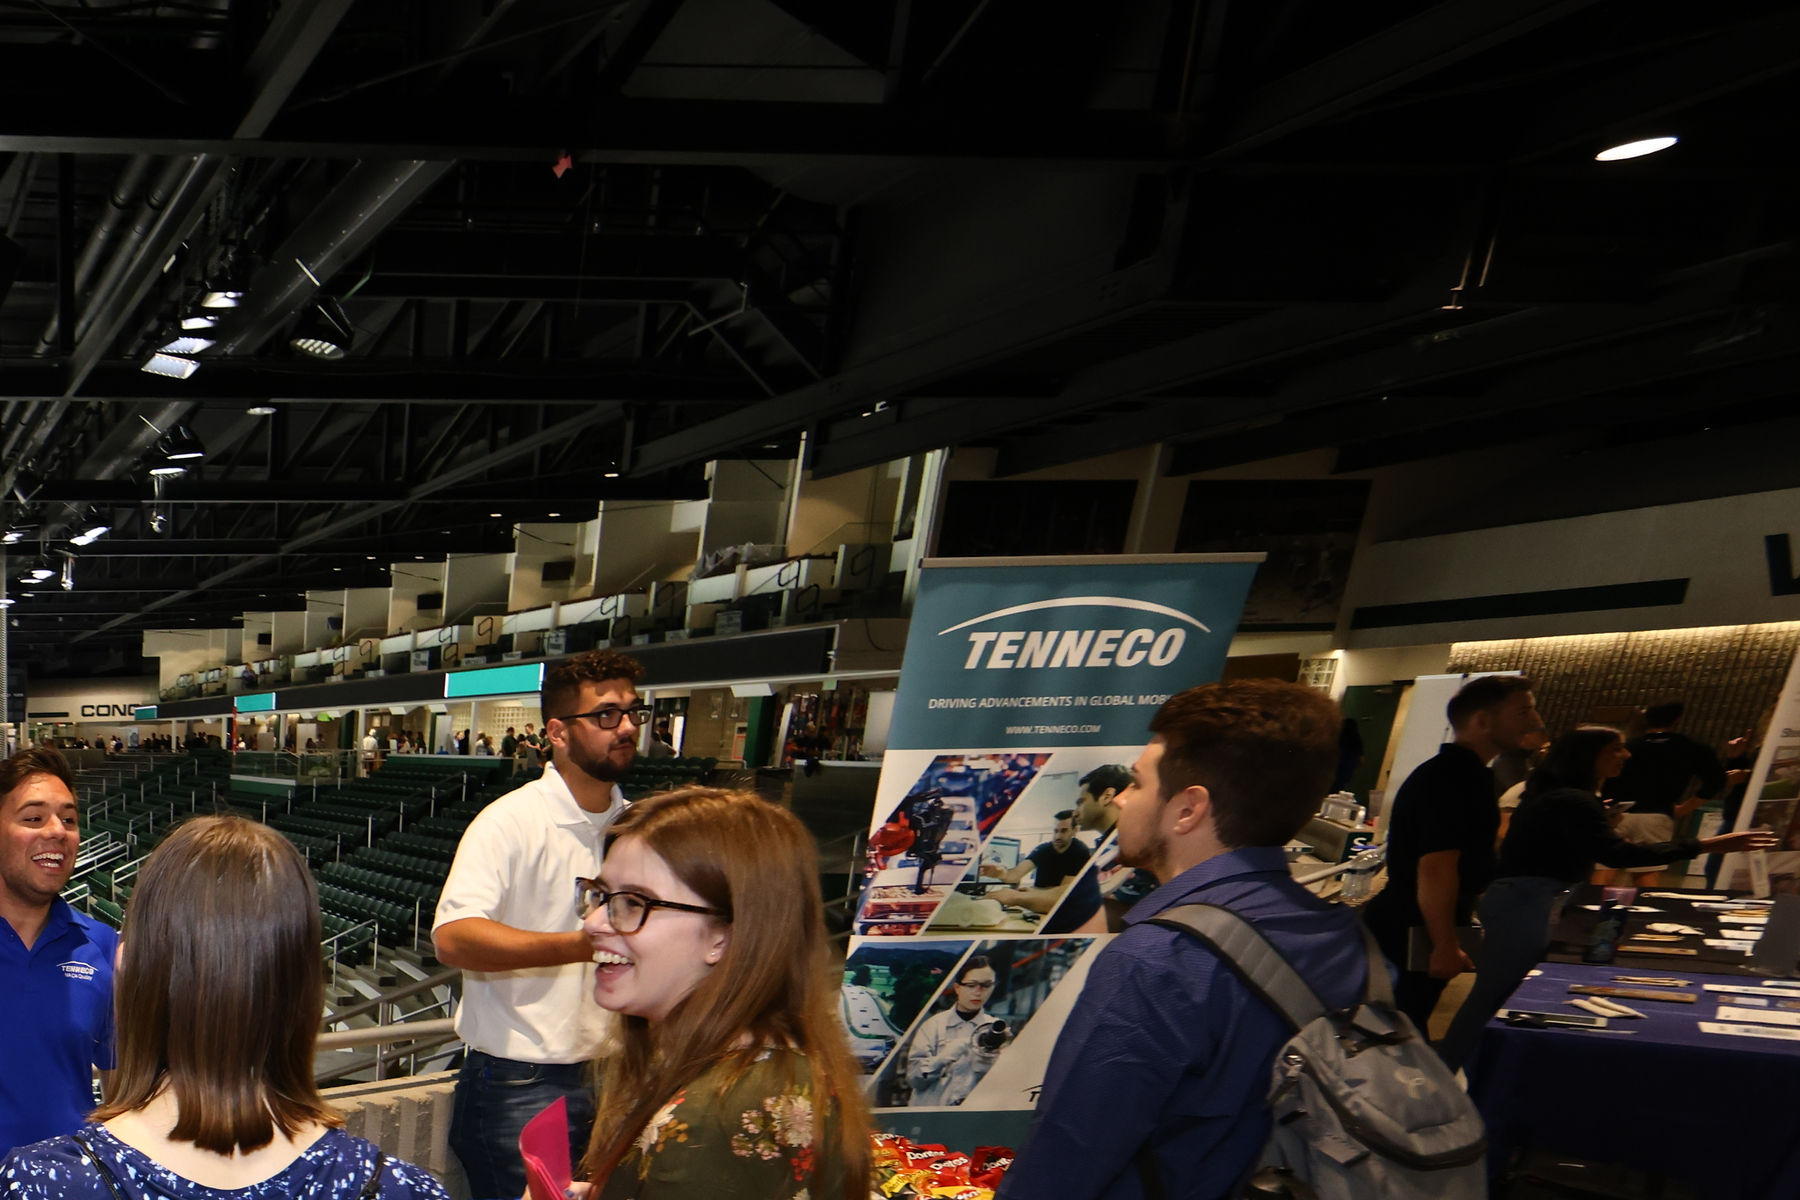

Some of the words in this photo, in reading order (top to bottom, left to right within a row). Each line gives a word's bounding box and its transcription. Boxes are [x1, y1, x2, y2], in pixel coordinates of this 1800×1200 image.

[964, 627, 1187, 670] TENNECO
[928, 698, 977, 709] DRIVING
[978, 696, 1073, 708] ADVANCEMENTS
[1074, 696, 1088, 707] IN
[1090, 695, 1136, 707] GLOBAL
[1005, 724, 1101, 735] WWW.TENNECO.COM
